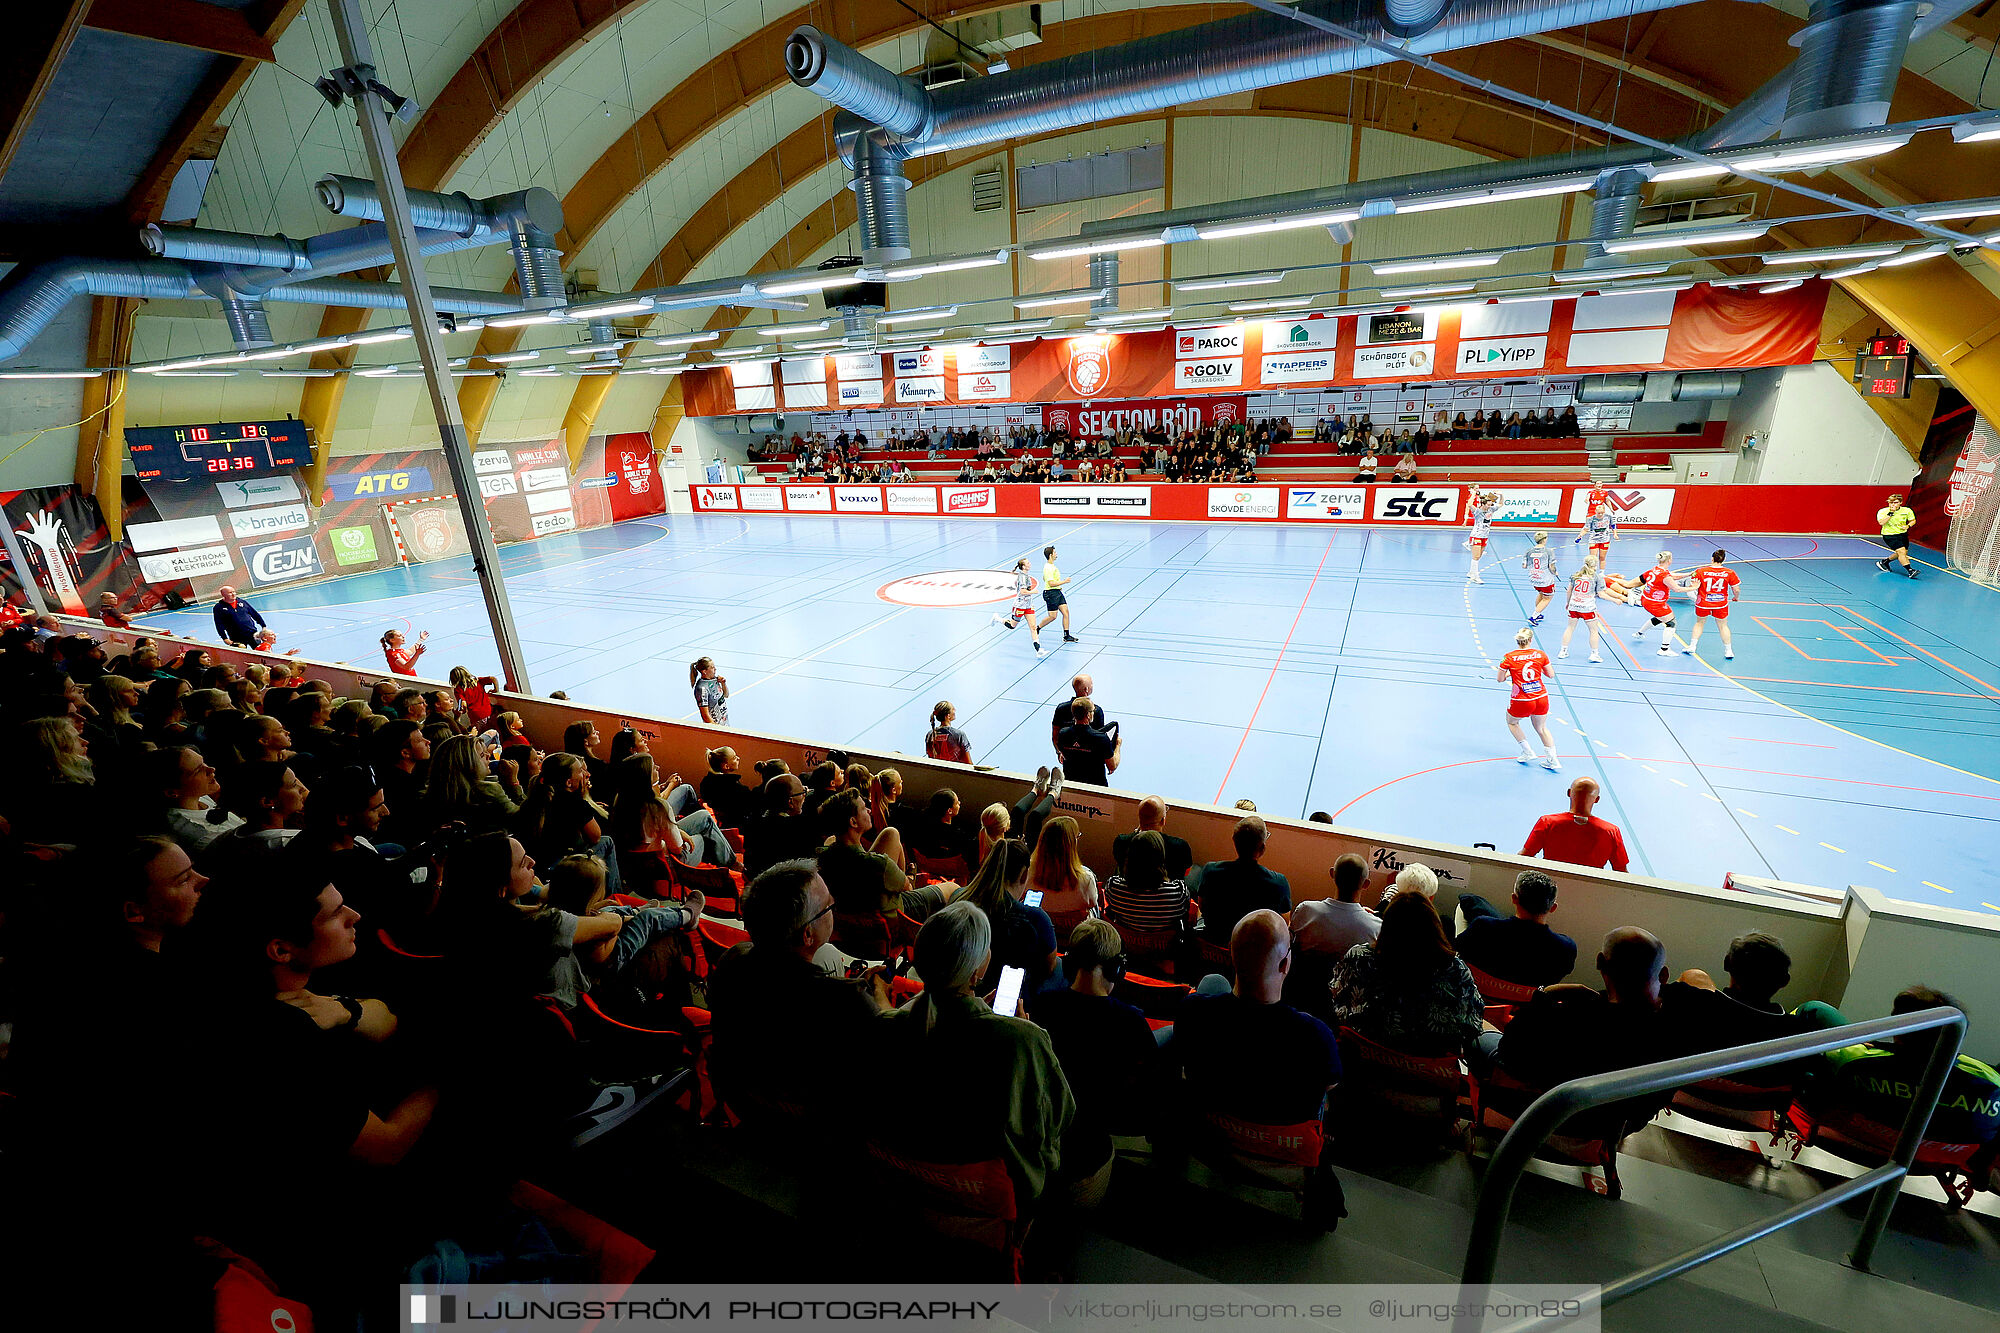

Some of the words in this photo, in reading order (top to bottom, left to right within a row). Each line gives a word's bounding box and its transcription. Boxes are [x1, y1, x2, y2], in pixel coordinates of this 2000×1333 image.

[1378, 321, 1412, 330] LIBANON
[1378, 328, 1399, 336] MEZE
[1407, 326, 1423, 334] BAR
[1198, 336, 1238, 350] PAROC
[900, 382, 944, 398] Kinnarps
[1078, 408, 1156, 436] SEKTION
[1162, 402, 1202, 434] RÖD
[174, 429, 186, 443] H
[190, 427, 209, 441] 10
[241, 425, 257, 438] 13
[258, 425, 269, 437] G
[130, 444, 153, 452] PLAYER
[544, 449, 560, 459] CUP
[207, 455, 255, 473] 28.36
[276, 457, 295, 465] PLAYER
[478, 456, 509, 467] zerva
[138, 469, 162, 478] PLAYER
[353, 472, 410, 496] ATG
[839, 495, 878, 503] VOLVO
[950, 490, 987, 506] GRAHNS
[1320, 494, 1362, 504] zerva
[1383, 491, 1449, 518] stc
[1504, 499, 1531, 507] GAME
[1532, 499, 1550, 507] ON!
[1210, 504, 1245, 513] SKÖVDE
[1245, 505, 1277, 514] ENERGI
[250, 511, 306, 530] bravida
[535, 515, 566, 530] redo
[174, 559, 224, 572] ELEKTRISKA
[252, 544, 314, 582] CEJN
[1533, 558, 1541, 570] 8
[1574, 579, 1590, 593] 20
[1703, 577, 1725, 593] 14
[1521, 660, 1536, 682] 6
